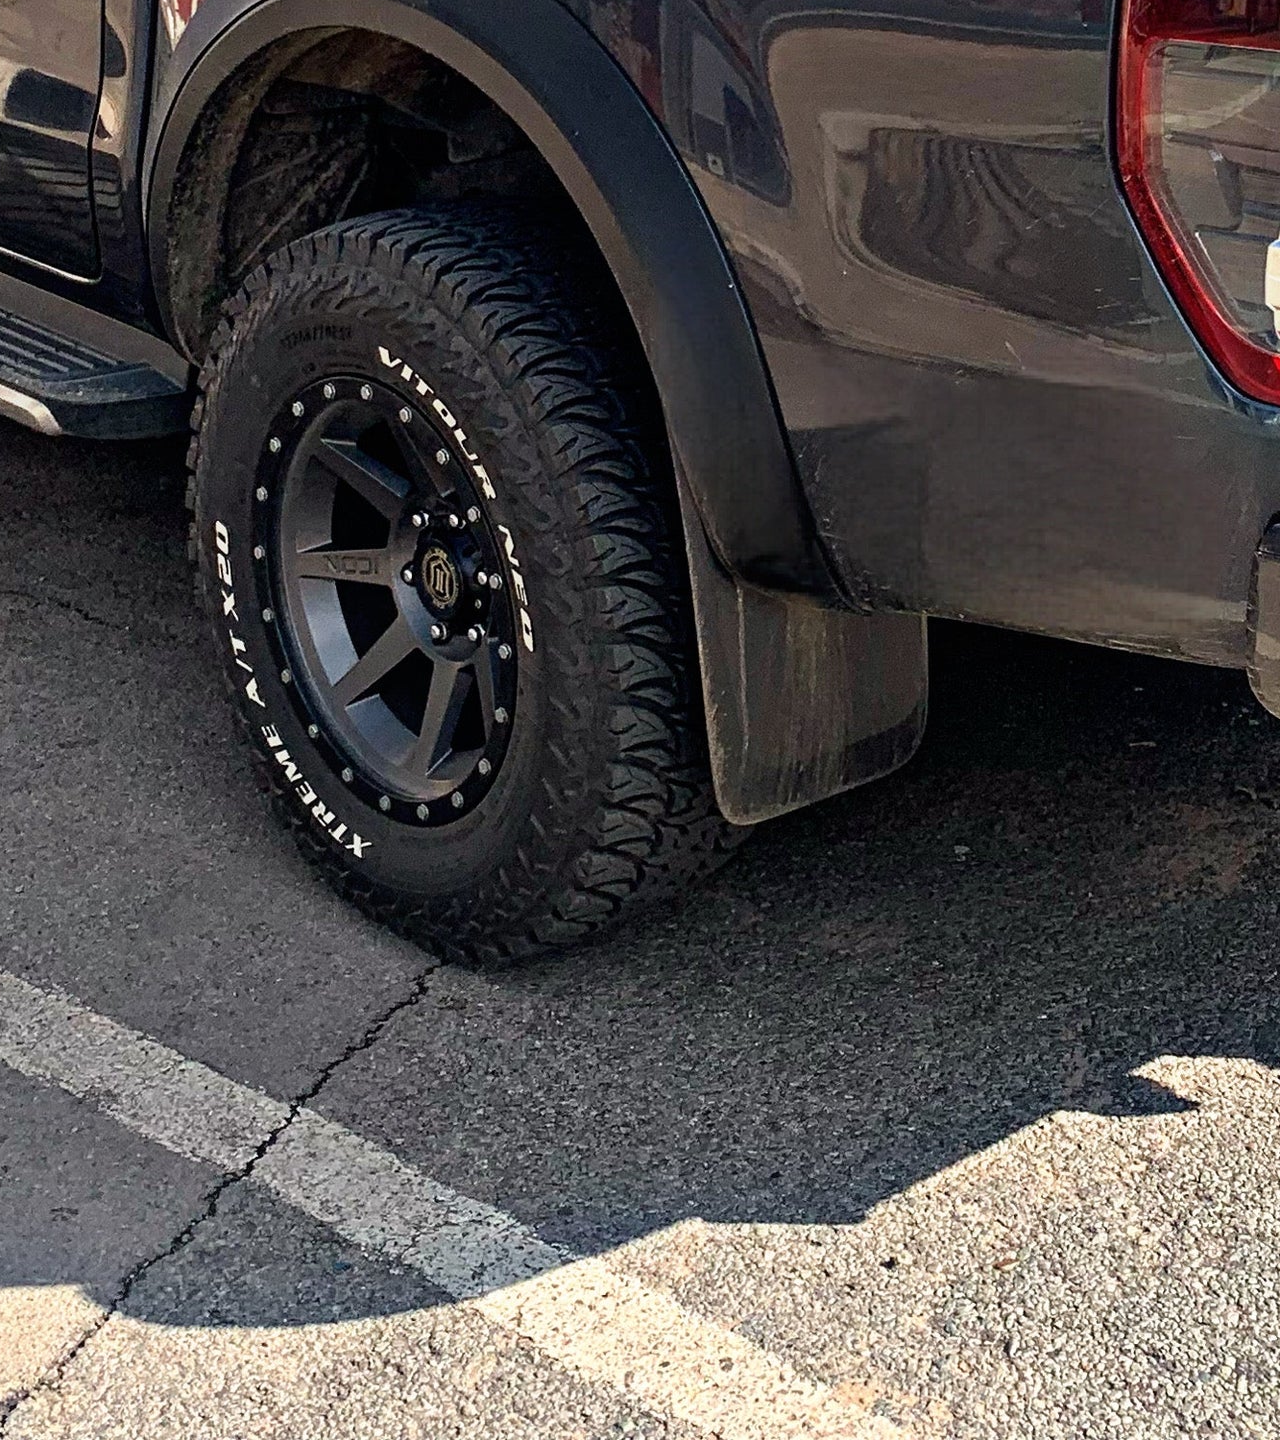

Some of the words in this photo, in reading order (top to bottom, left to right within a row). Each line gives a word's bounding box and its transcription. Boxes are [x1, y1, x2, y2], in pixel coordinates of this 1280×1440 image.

[378, 345, 497, 499] VITOUR
[215, 520, 240, 622] X20
[229, 629, 267, 709] A/T
[260, 724, 372, 859] XTREME
